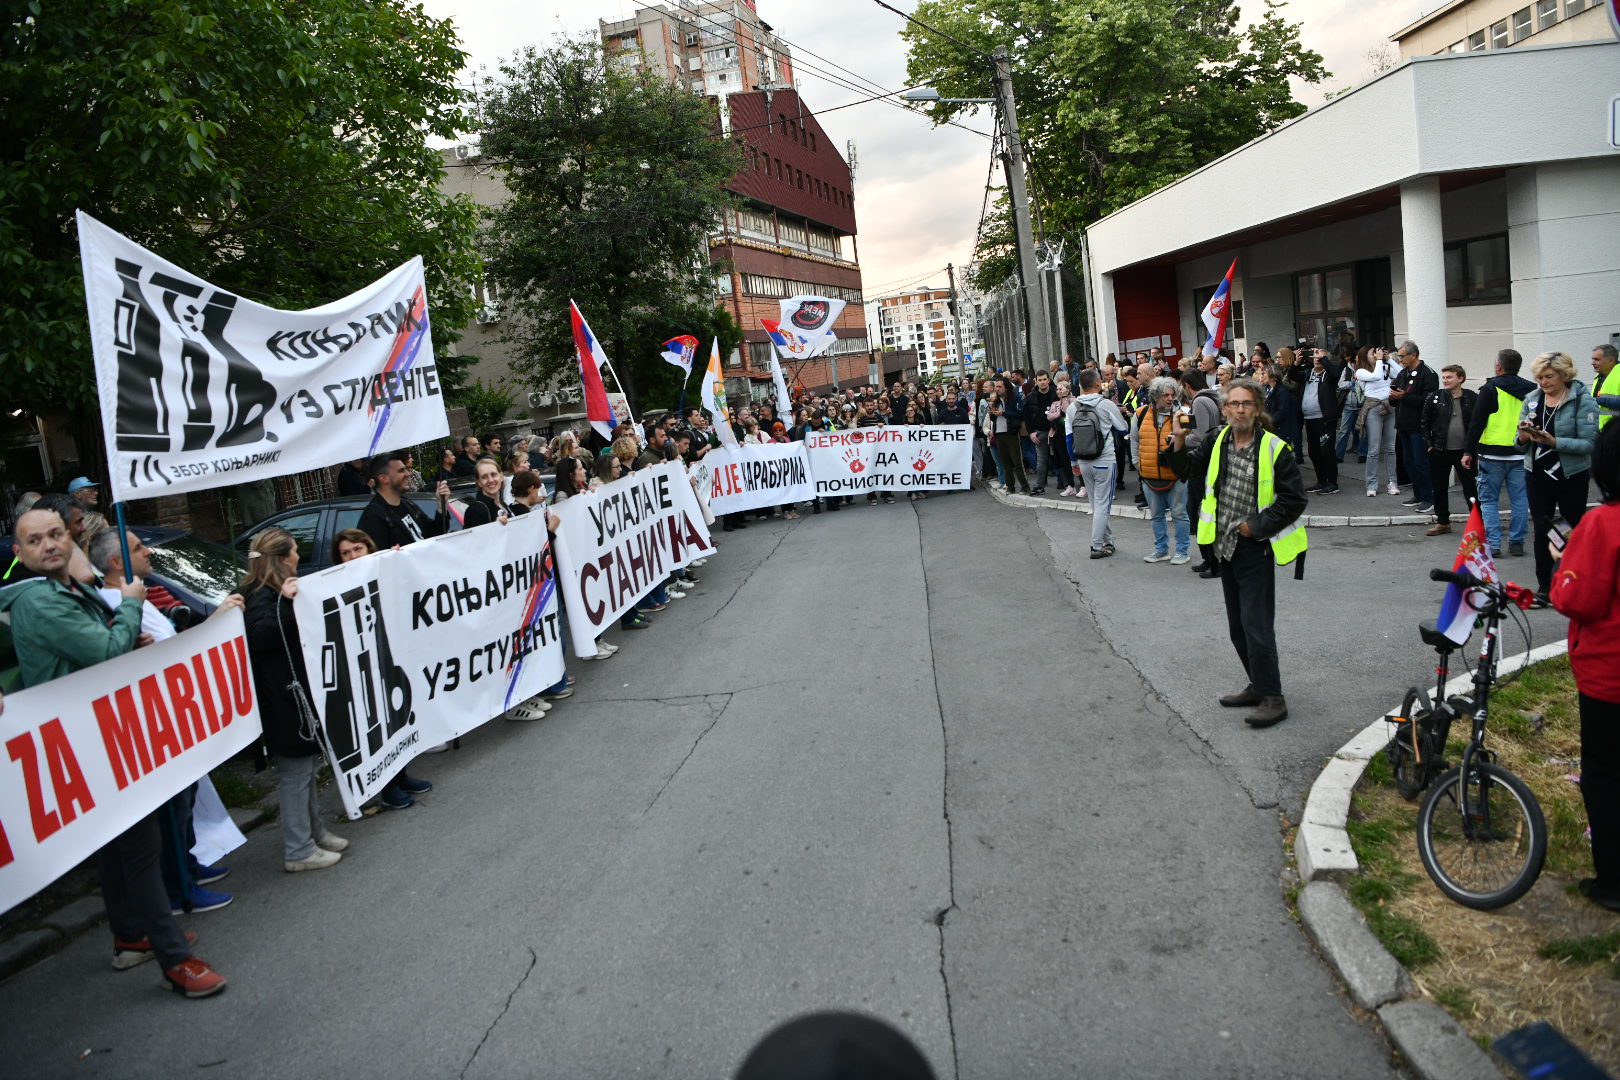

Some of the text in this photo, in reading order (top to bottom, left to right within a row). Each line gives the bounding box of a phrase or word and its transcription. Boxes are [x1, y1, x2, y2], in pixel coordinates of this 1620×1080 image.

[323, 365, 440, 416] СТУДЕНТЕ
[908, 429, 966, 442] КРЕЋЕ
[170, 450, 282, 478] ЗБОР КОЊАРНИК!
[741, 456, 807, 492] КАРАБУРМА
[875, 452, 899, 467] ДА
[816, 473, 962, 493] ПОЧИСТИ СМЕЋЕ
[412, 548, 555, 630] КОЊАРНИК
[422, 657, 460, 701] УЗ
[5, 635, 253, 844] ZA MARIJU
[366, 730, 419, 786] ЗБОР КОЊАРНИК!
